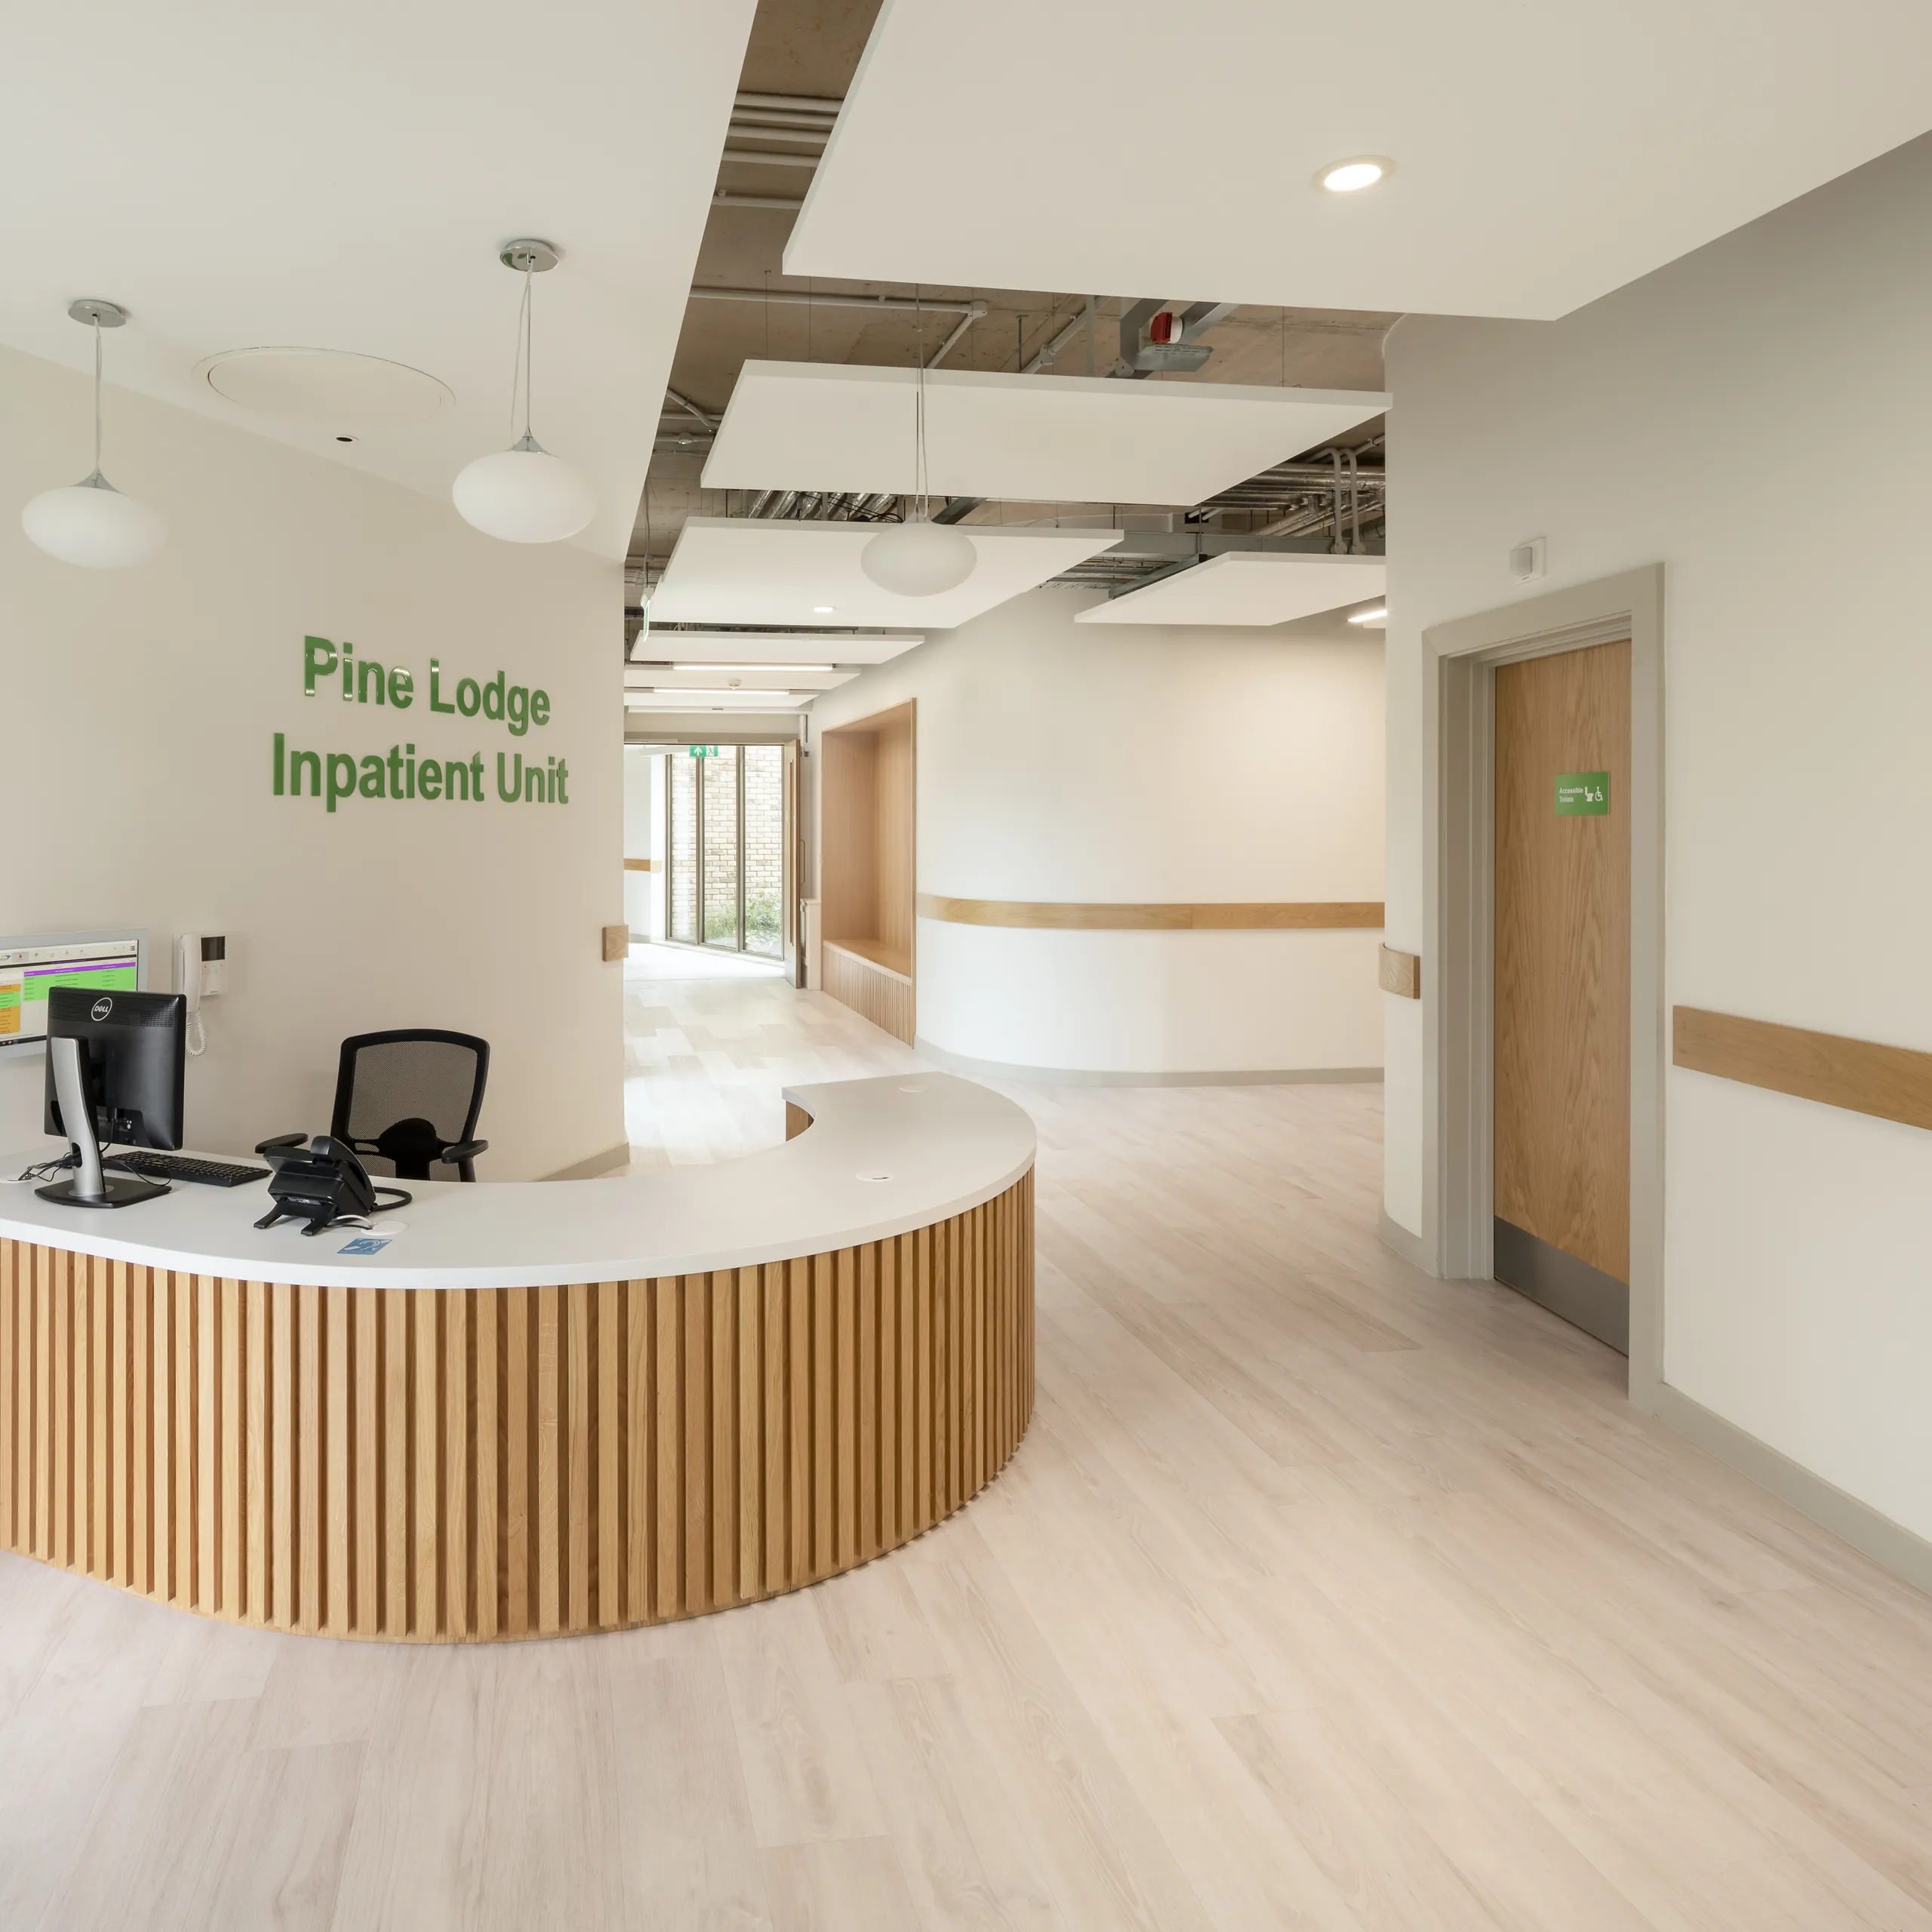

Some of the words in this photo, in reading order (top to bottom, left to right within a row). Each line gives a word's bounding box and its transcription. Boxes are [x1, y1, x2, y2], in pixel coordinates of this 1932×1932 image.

[305, 635, 414, 709] Pine
[430, 657, 551, 737] Lodge
[273, 732, 485, 813] Inpatient
[497, 751, 569, 804] Unit
